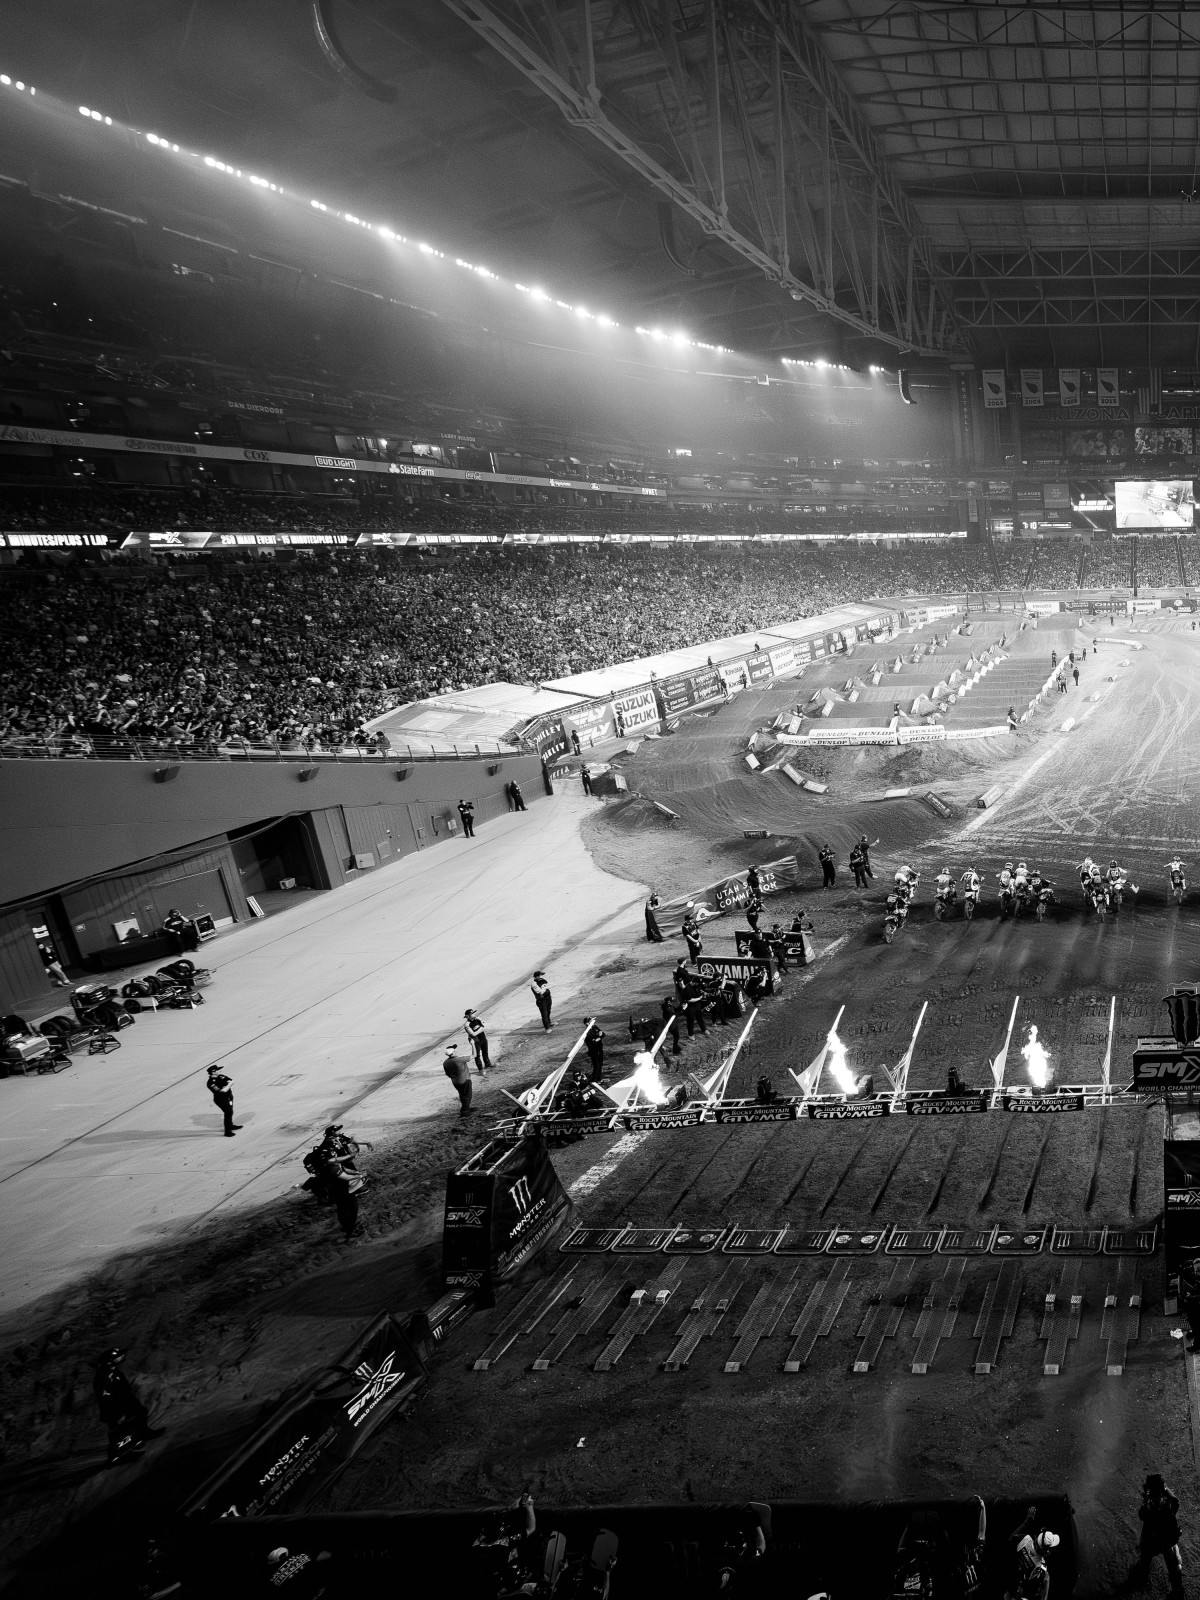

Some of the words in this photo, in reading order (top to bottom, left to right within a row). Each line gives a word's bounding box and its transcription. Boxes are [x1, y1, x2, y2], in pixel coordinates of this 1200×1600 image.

[318, 457, 334, 466] BUD
[334, 459, 355, 468] LIGHT
[91, 535, 108, 546] LAP
[614, 692, 655, 713] SUZUKI
[622, 708, 657, 729] UZUKI
[716, 884, 740, 900] UTAH
[743, 872, 775, 889] SRTS
[658, 1113, 697, 1121] MOUNTAIN
[446, 1209, 487, 1225] SMX
[509, 1198, 547, 1239] MONSTER
[514, 1218, 555, 1263] CHAMPIONSHIP
[446, 1272, 485, 1288] SMX
[347, 1357, 402, 1421] SMX
[353, 1408, 370, 1428] WORLD
[259, 1435, 310, 1486] MONSTER
